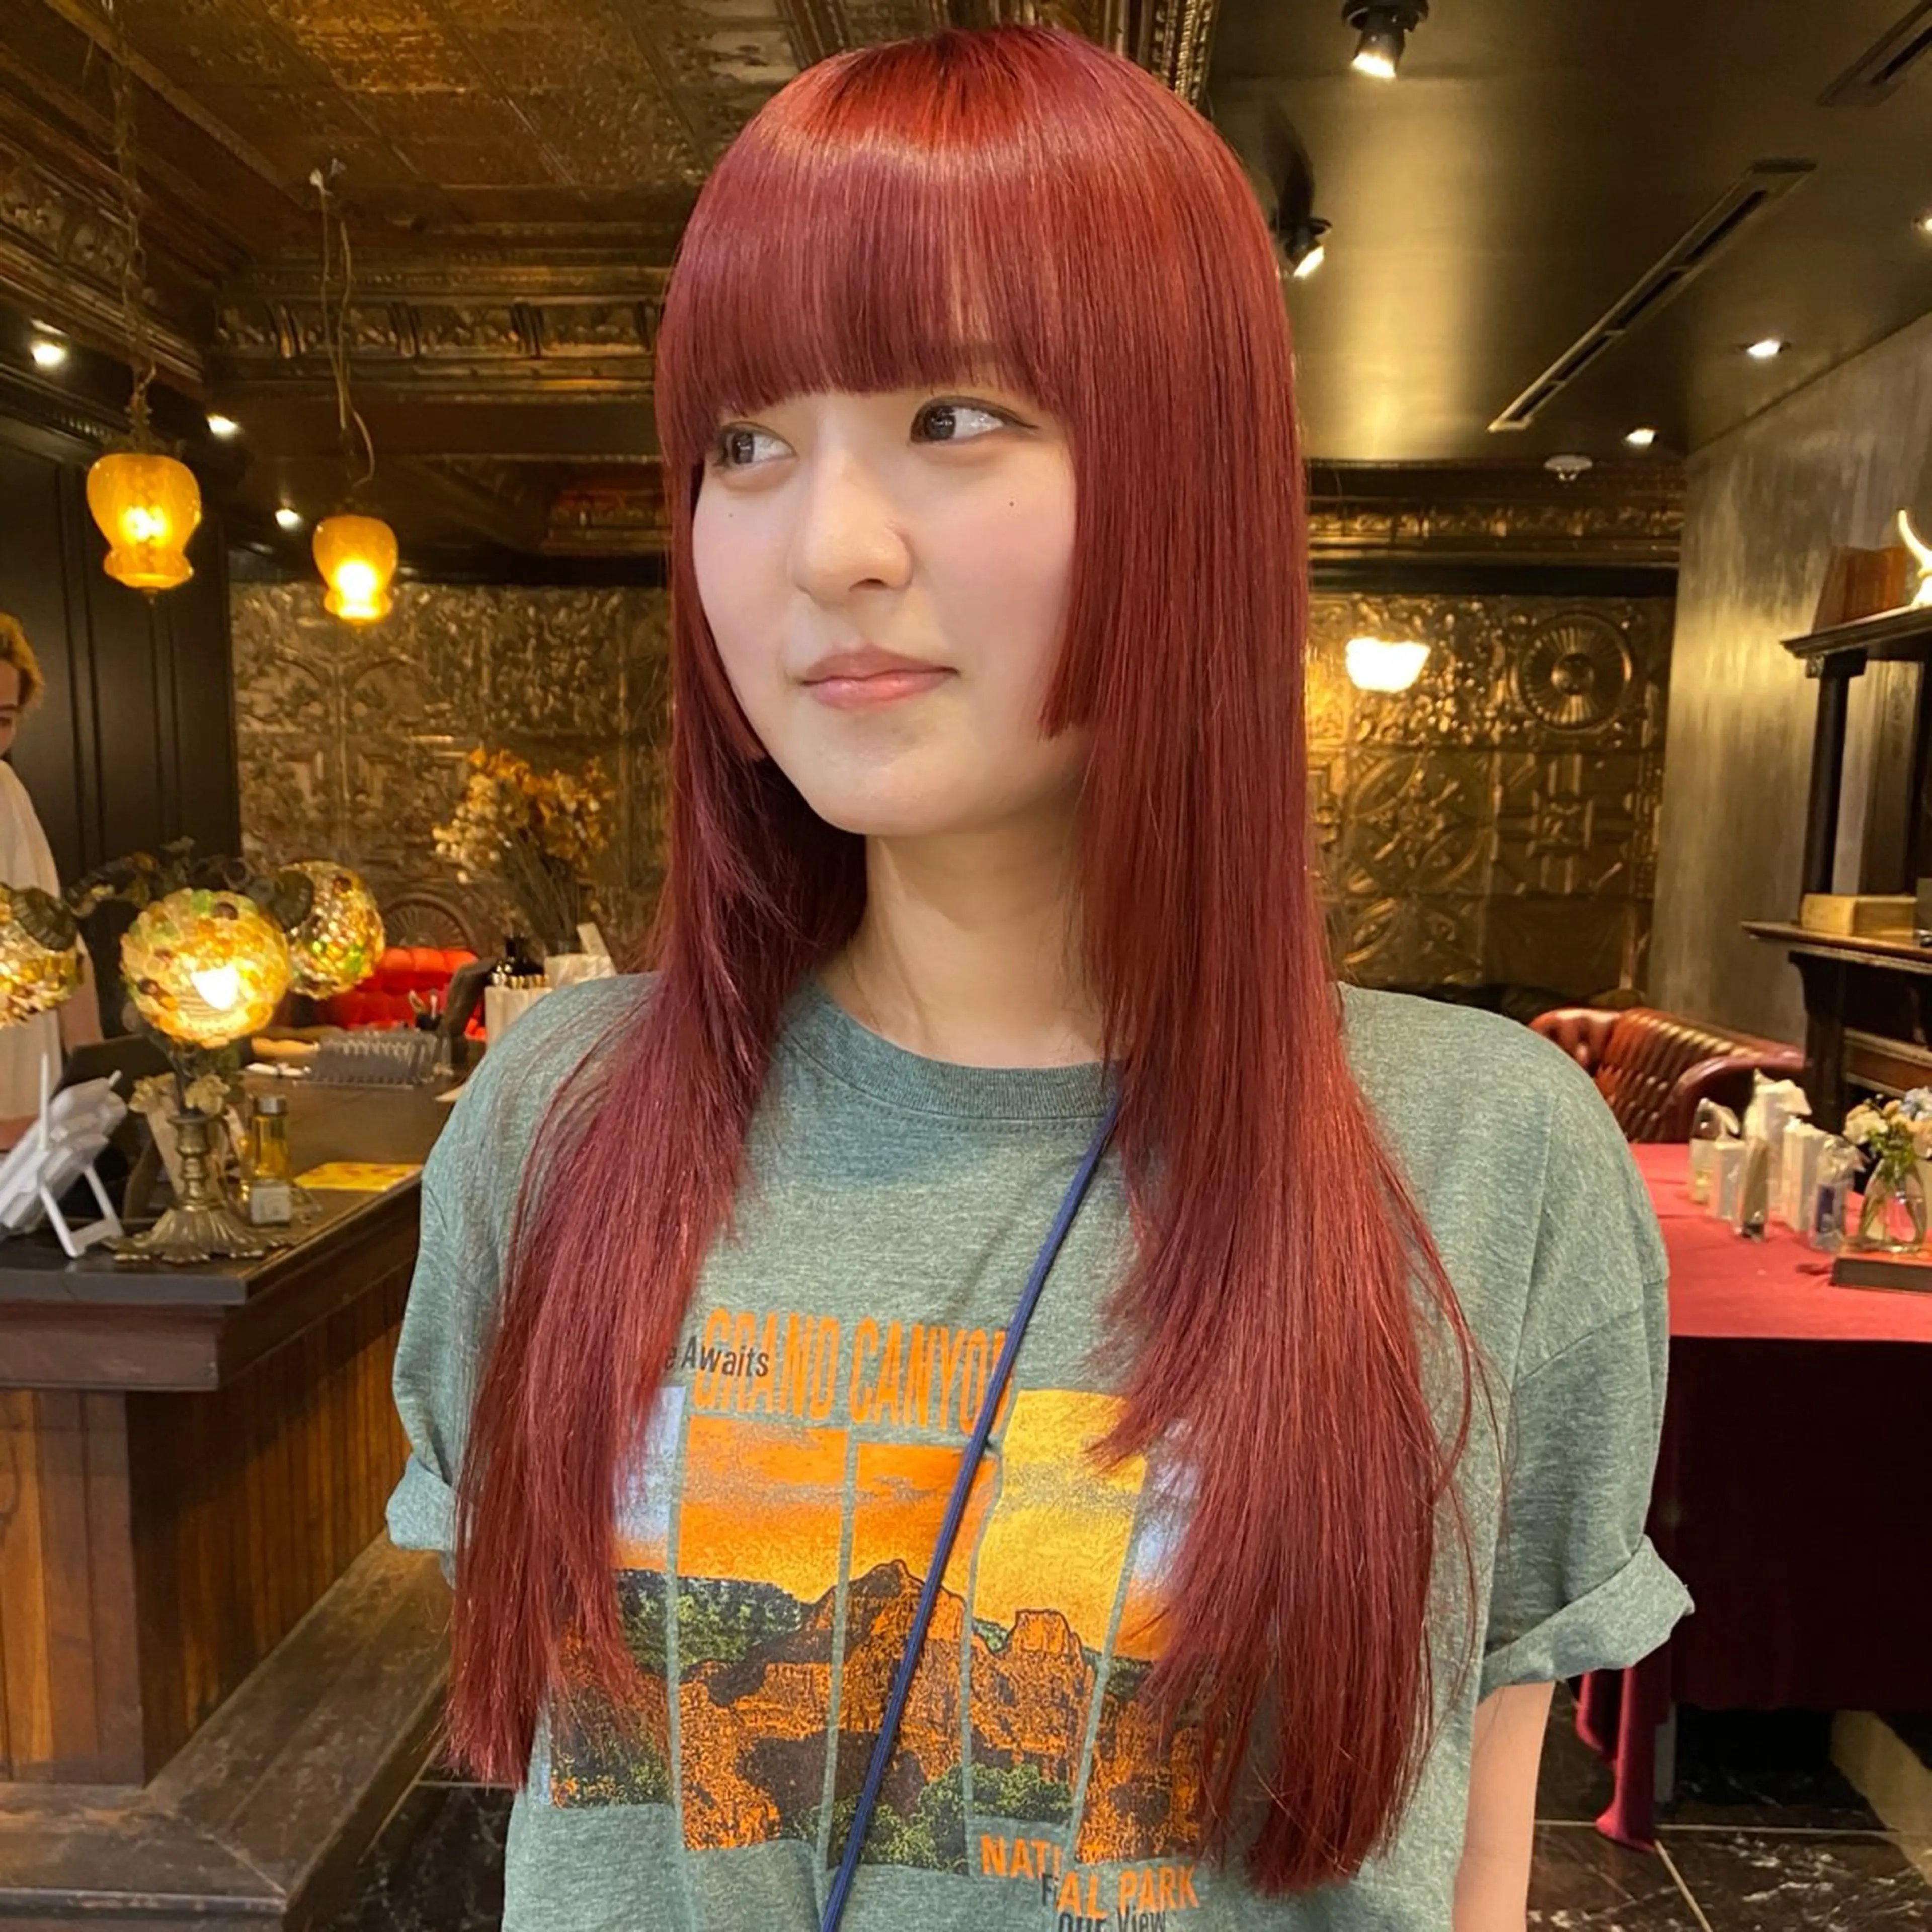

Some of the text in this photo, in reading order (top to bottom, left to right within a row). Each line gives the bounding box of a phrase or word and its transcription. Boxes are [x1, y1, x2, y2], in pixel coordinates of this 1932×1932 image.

[681, 1335, 770, 1377] Awaits
[693, 1306, 839, 1420] GRAND
[1118, 1864, 1199, 1915] PARK
